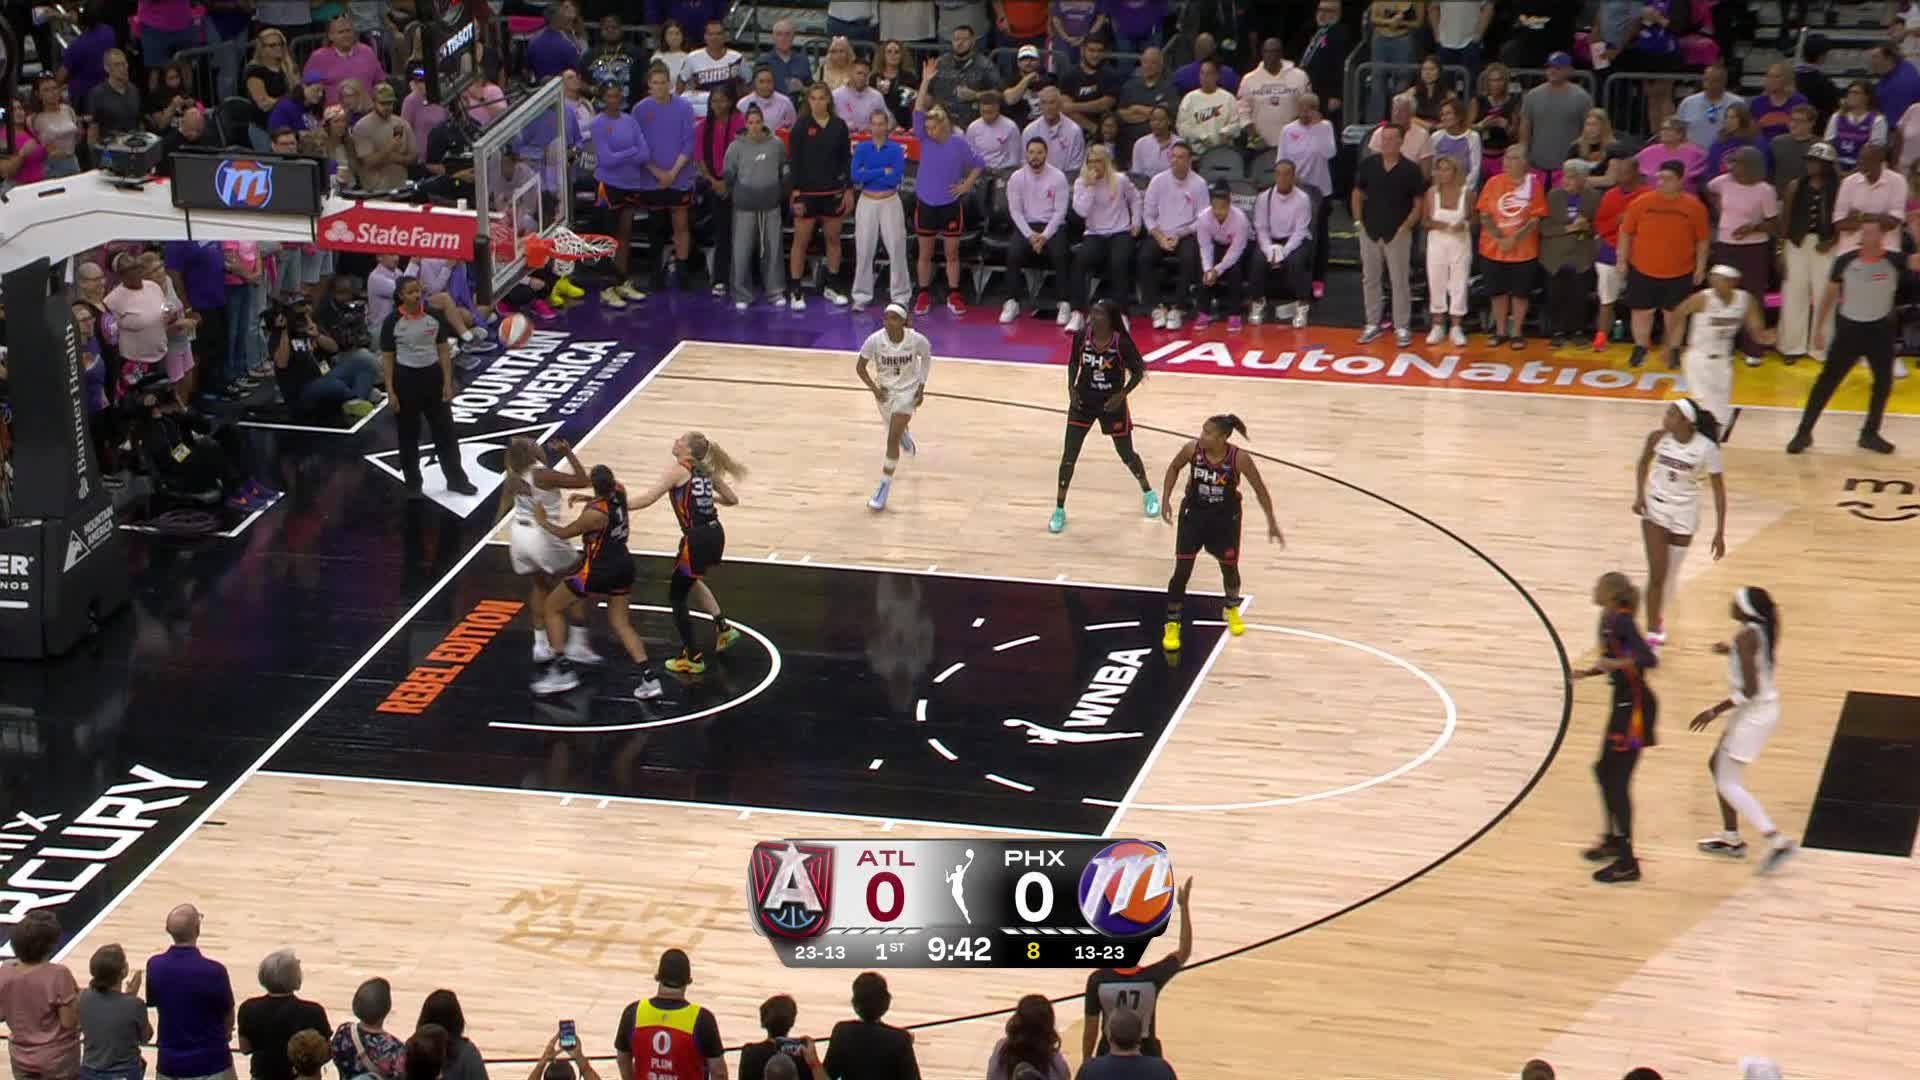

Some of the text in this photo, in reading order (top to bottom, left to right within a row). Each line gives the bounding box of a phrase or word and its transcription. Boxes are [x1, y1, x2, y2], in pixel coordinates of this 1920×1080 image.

[446, 22, 473, 56] TISSOT
[65, 322, 88, 474] Banner Health
[450, 329, 571, 424] MOUNTAIN
[496, 340, 619, 422] AMERICA
[692, 476, 713, 496] 33
[1194, 466, 1228, 486] PHX
[376, 599, 526, 715] REBEL EDITION
[1063, 648, 1153, 728] WNBA
[0, 763, 209, 957] RCURY
[652, 1030, 671, 1056] 0
